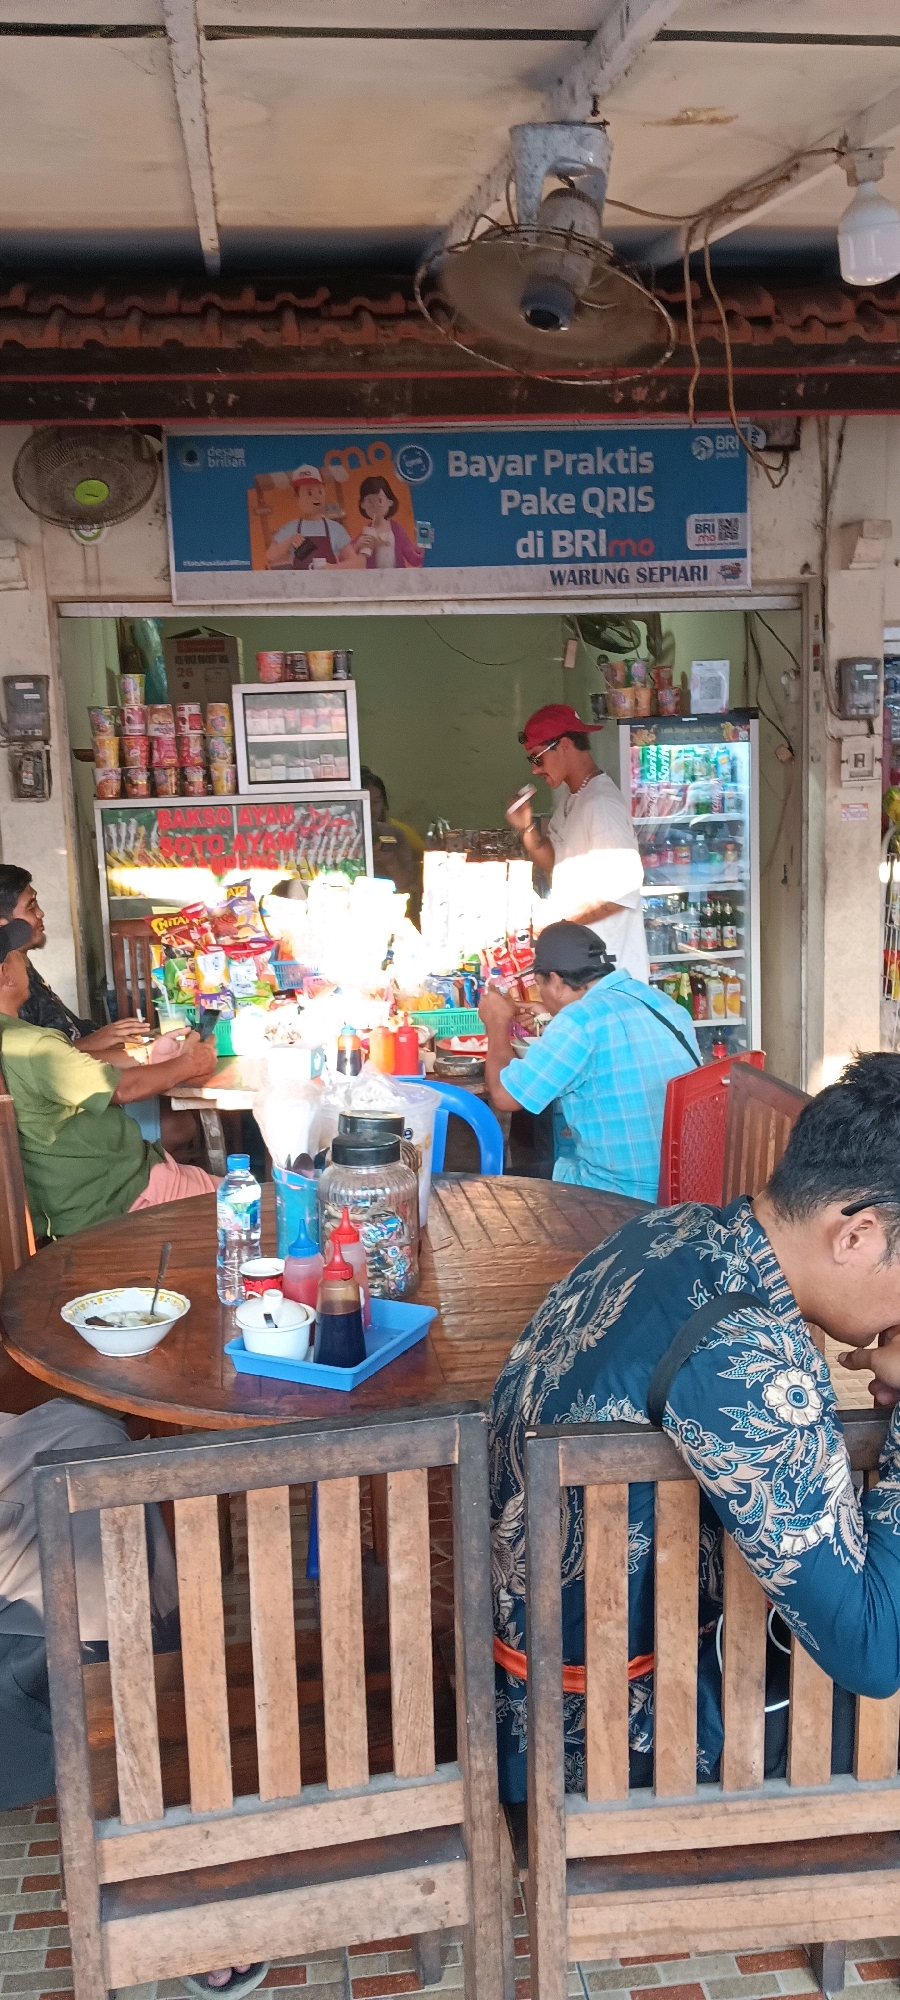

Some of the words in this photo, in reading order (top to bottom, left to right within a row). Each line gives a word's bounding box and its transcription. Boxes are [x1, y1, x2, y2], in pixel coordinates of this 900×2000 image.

[715, 435, 740, 450] BRI
[448, 450, 537, 482] Bayar
[544, 446, 655, 475] Praktis
[501, 488, 576, 516] Pake
[582, 485, 655, 518] QRIS
[695, 523, 715, 534] BRI
[516, 530, 544, 558] di
[550, 567, 630, 586] WARUNG
[636, 564, 708, 583] SEPIARI
[157, 807, 231, 830] BAKSO
[238, 804, 294, 826] AYAM
[160, 834, 224, 857] SOTO
[232, 831, 297, 853] AYAM
